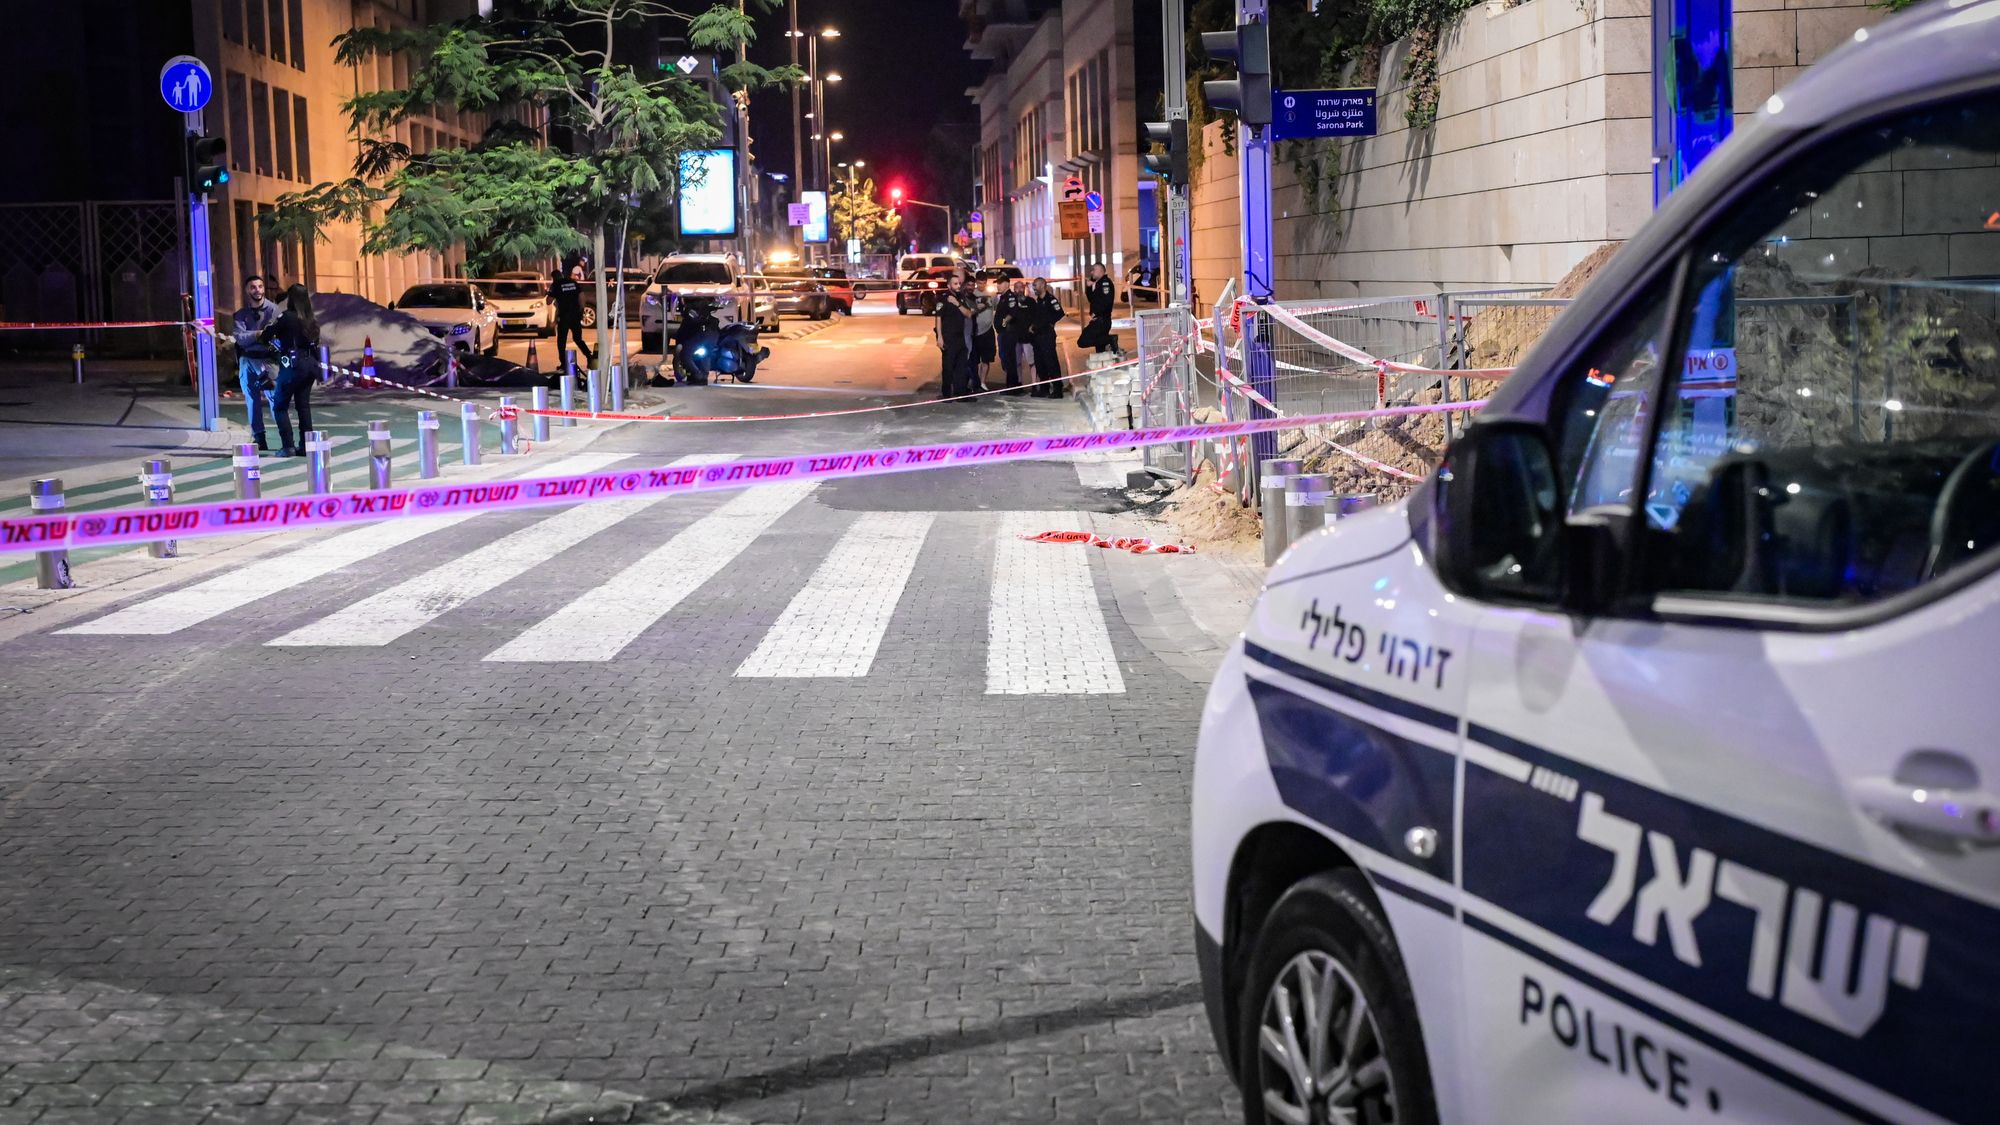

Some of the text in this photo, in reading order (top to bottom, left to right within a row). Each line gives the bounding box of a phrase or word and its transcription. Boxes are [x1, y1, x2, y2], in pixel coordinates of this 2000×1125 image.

[1317, 98, 1364, 107] פארק שרונה
[1316, 121, 1364, 130] Sarona Park
[1687, 356, 1708, 375] אין
[1045, 436, 1083, 450] מעבר
[1084, 434, 1106, 451] אין
[1129, 429, 1173, 443] ישראל
[905, 447, 953, 464] ישראל
[973, 440, 1034, 457] משטרת
[726, 461, 794, 480] משטרת
[808, 455, 852, 472] מעבר
[852, 453, 878, 472] אין
[535, 478, 586, 498] מעבר
[588, 475, 616, 498] אין
[648, 468, 703, 488] ישראל
[350, 493, 416, 514] ישראל
[443, 484, 520, 506] משטרת
[111, 508, 201, 534] משטרת
[218, 503, 279, 525] מעבר
[282, 501, 313, 525] אין
[1, 519, 77, 544] ישראל
[1301, 598, 1452, 689] זיהוי פלילי
[1577, 791, 1929, 1039] ישראל
[1520, 975, 1689, 1109] POLICE
